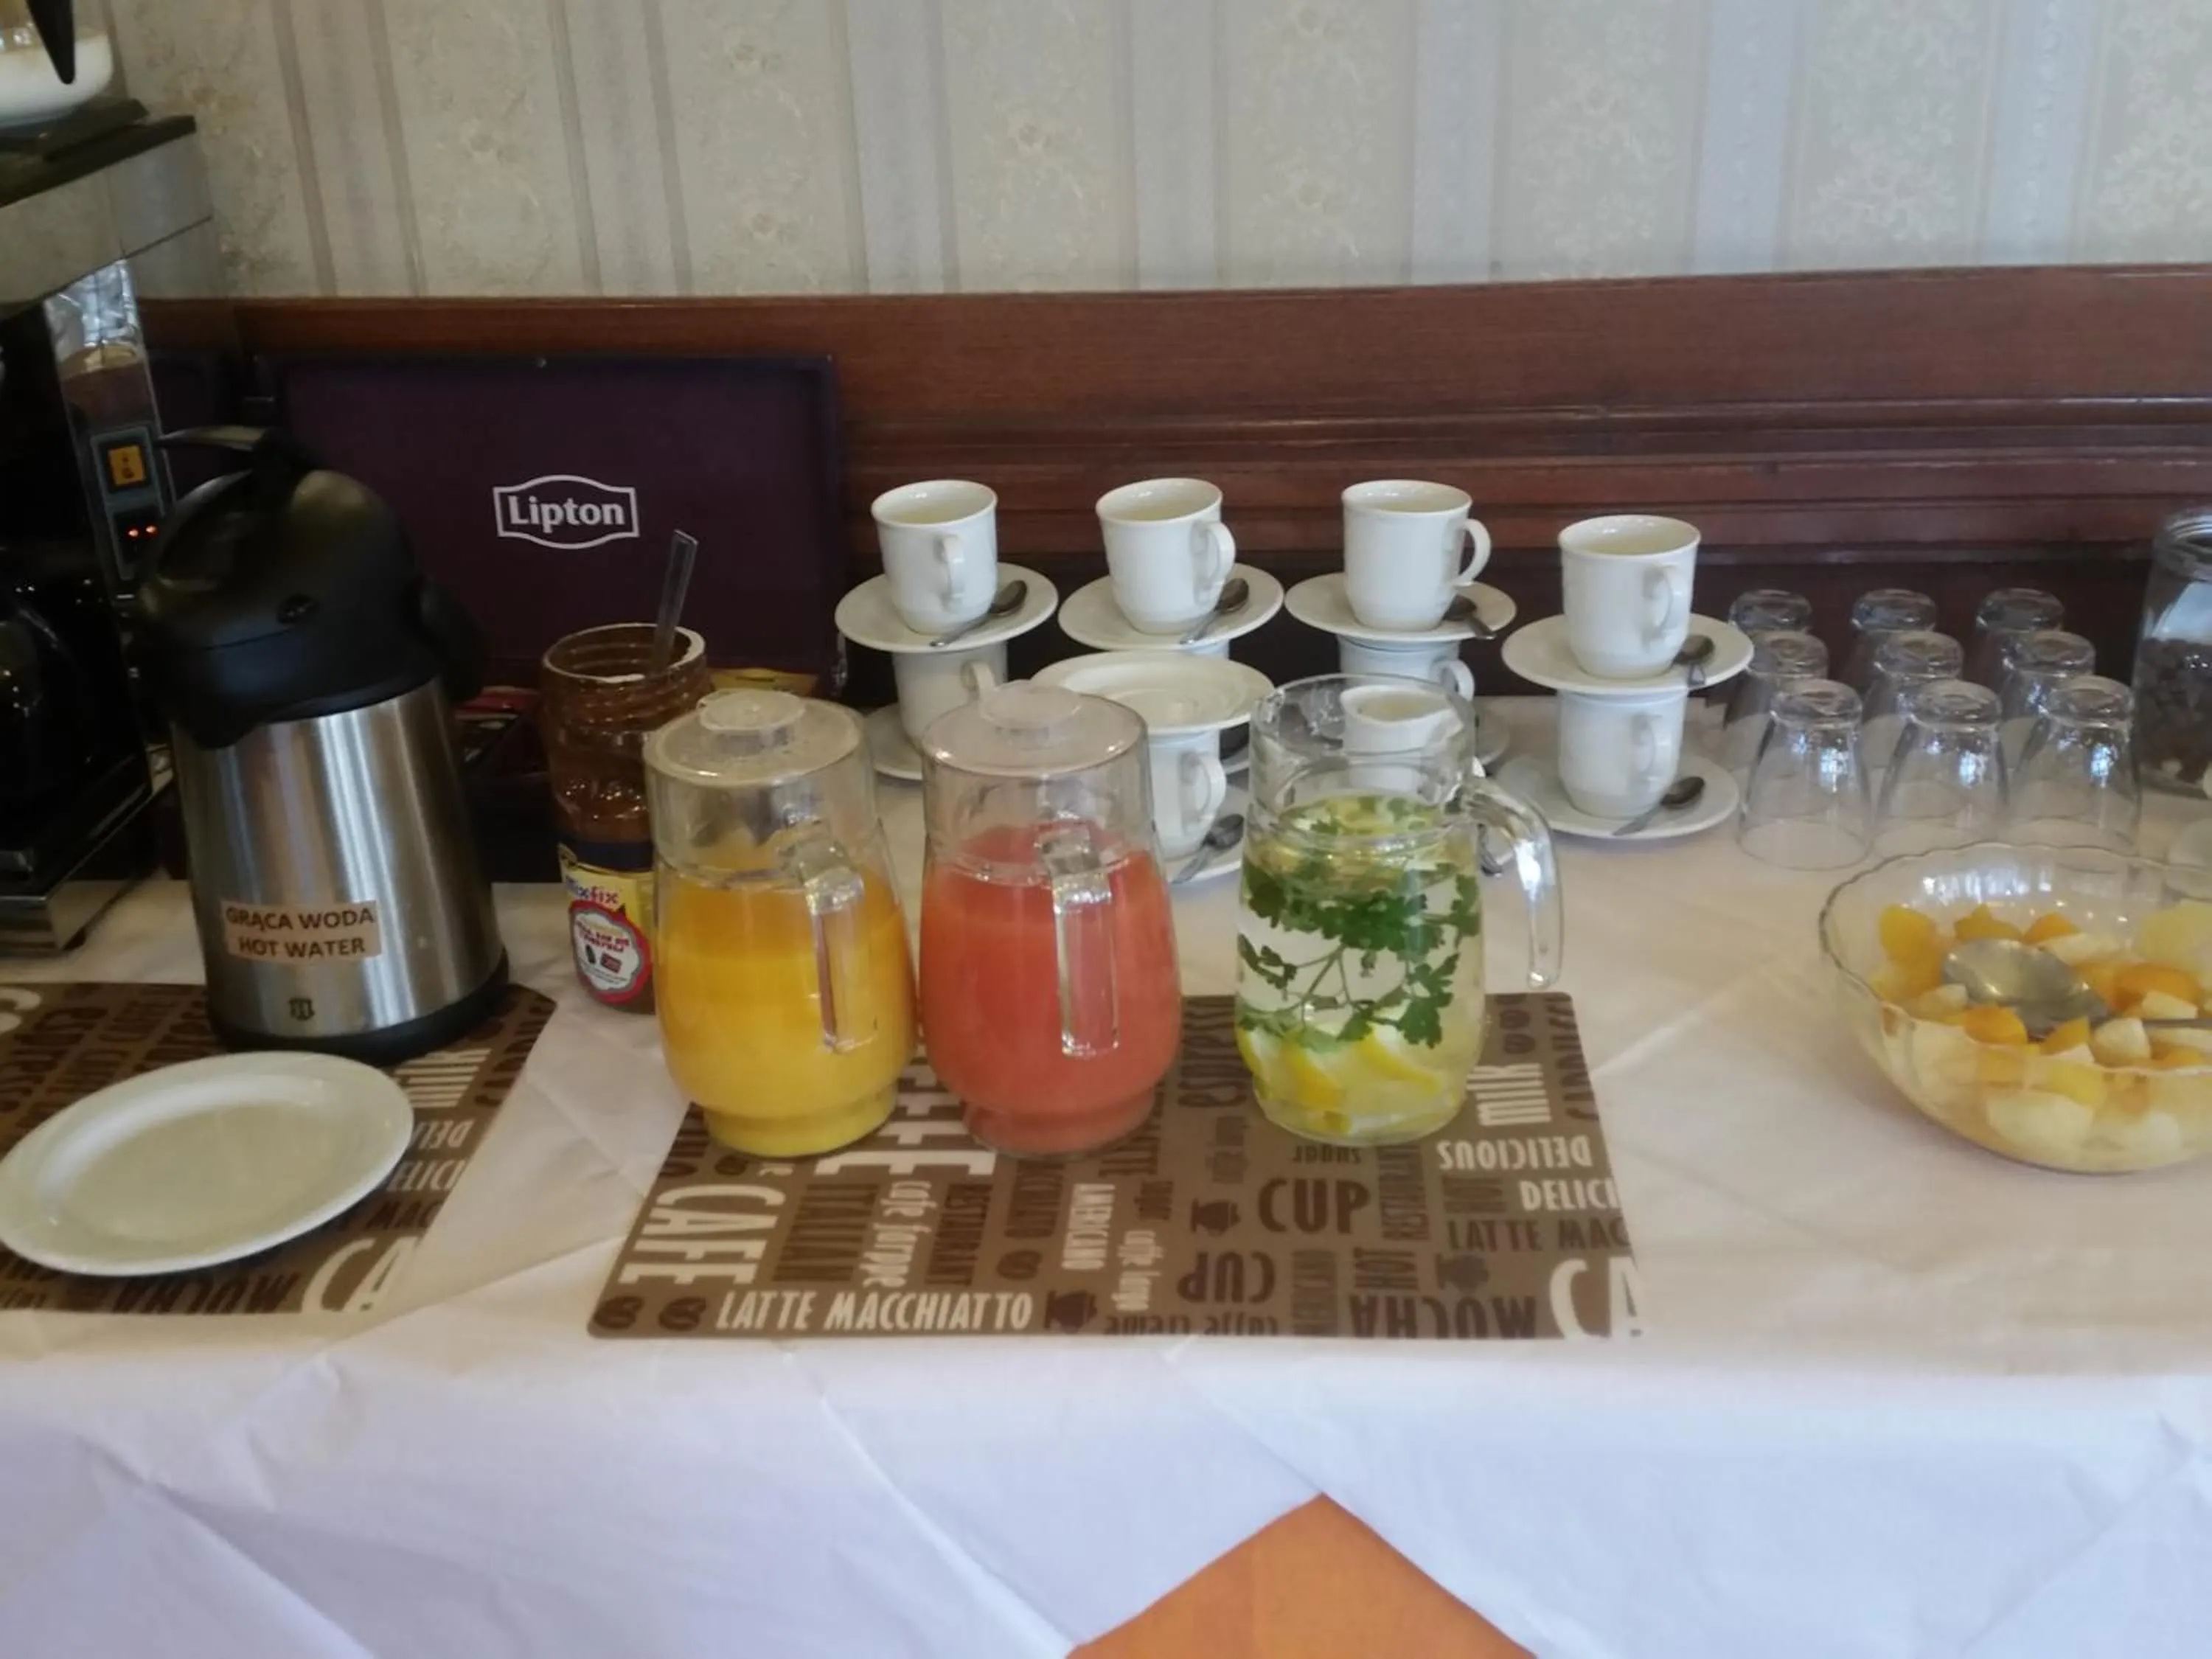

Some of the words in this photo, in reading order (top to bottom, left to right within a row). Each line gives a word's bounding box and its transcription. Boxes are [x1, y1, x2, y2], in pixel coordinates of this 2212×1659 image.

[507, 495, 625, 533] Lipton
[298, 908, 375, 929] WODA
[239, 937, 278, 956] HOT
[285, 937, 365, 958] WATER
[1437, 1135, 1593, 1171] DELICIOUS
[1258, 1178, 1371, 1234] CUP
[618, 1185, 786, 1284] CAFE
[1447, 1219, 1546, 1252] LATTE
[1177, 1252, 1276, 1304] CUP
[715, 1291, 816, 1330] LATTE
[823, 1292, 1034, 1332] MACCHIATTO
